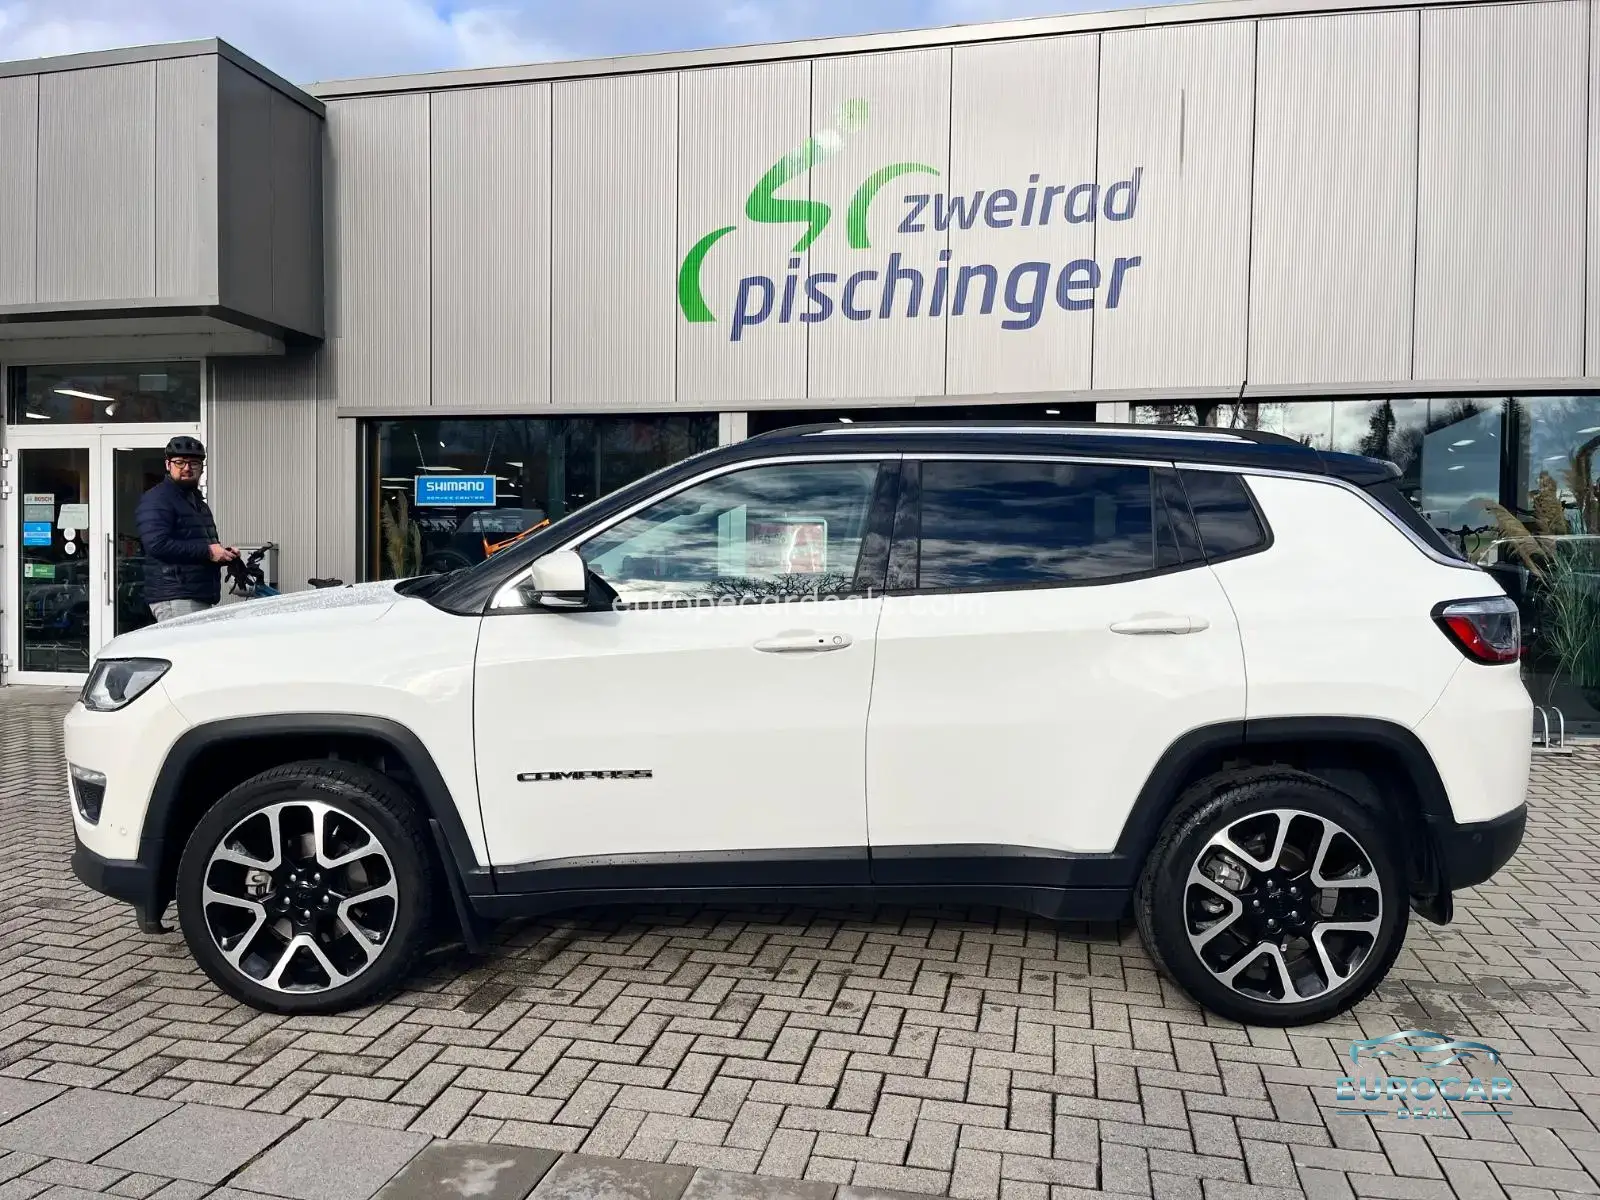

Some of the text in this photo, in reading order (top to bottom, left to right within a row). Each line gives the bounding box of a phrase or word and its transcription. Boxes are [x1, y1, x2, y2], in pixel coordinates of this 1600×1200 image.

[897, 167, 1143, 233] zweirad
[730, 250, 1141, 342] pischinger
[426, 481, 485, 492] SHIMANO
[516, 769, 653, 782] COMPASS
